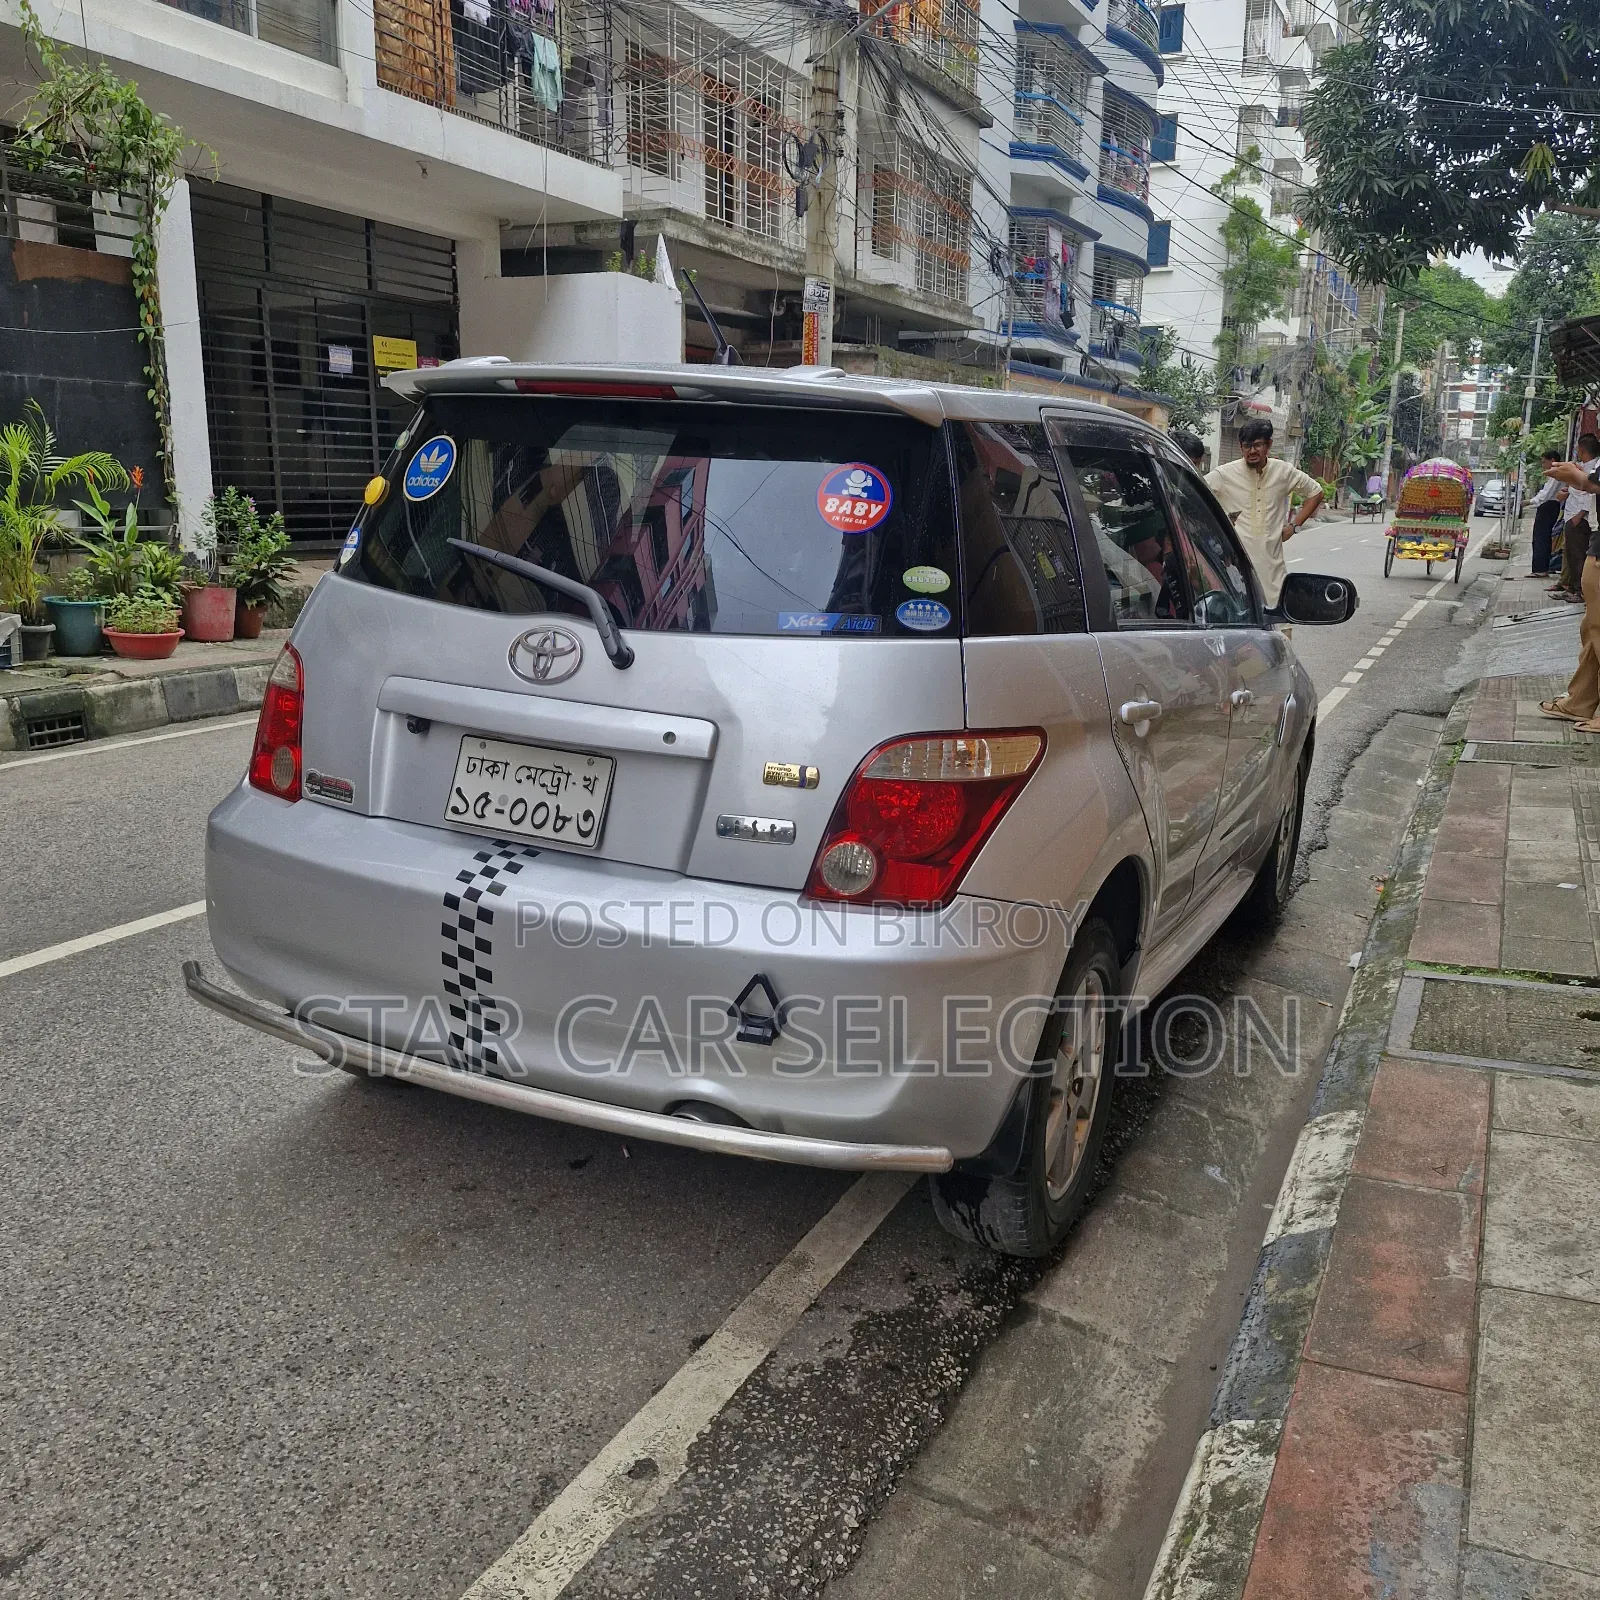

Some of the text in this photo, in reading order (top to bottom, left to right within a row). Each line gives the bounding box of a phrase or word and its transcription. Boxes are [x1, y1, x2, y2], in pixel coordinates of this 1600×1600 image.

[407, 474, 441, 487] adidas
[824, 497, 883, 519] BABY
[782, 614, 877, 630] Netz Aichi
[466, 756, 511, 780] ঢাকা
[451, 786, 595, 838] ১৫-০০৮৩
